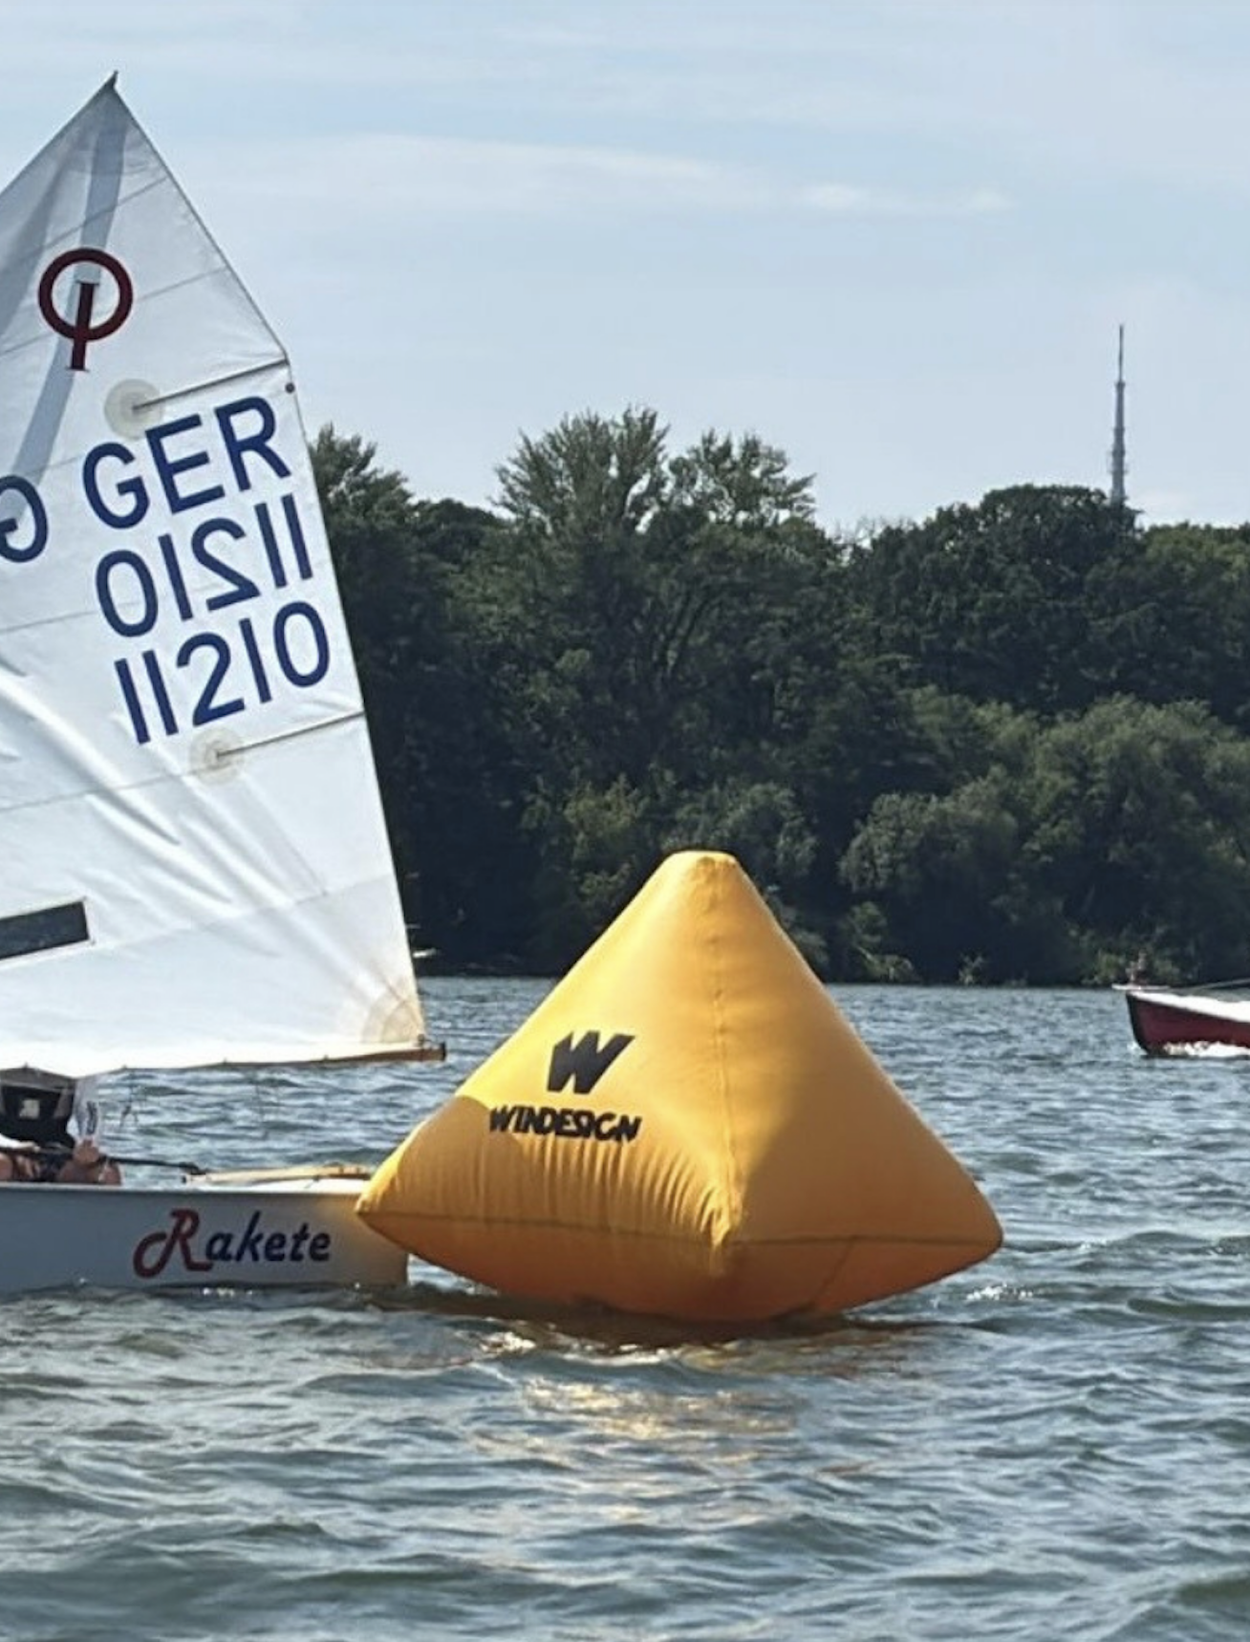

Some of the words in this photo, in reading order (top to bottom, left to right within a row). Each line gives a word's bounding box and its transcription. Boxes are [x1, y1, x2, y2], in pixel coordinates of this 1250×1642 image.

[82, 396, 292, 530] GER
[114, 601, 331, 745] 11210
[489, 1104, 642, 1143] WINDESIGN
[132, 1207, 332, 1279] Rakete
